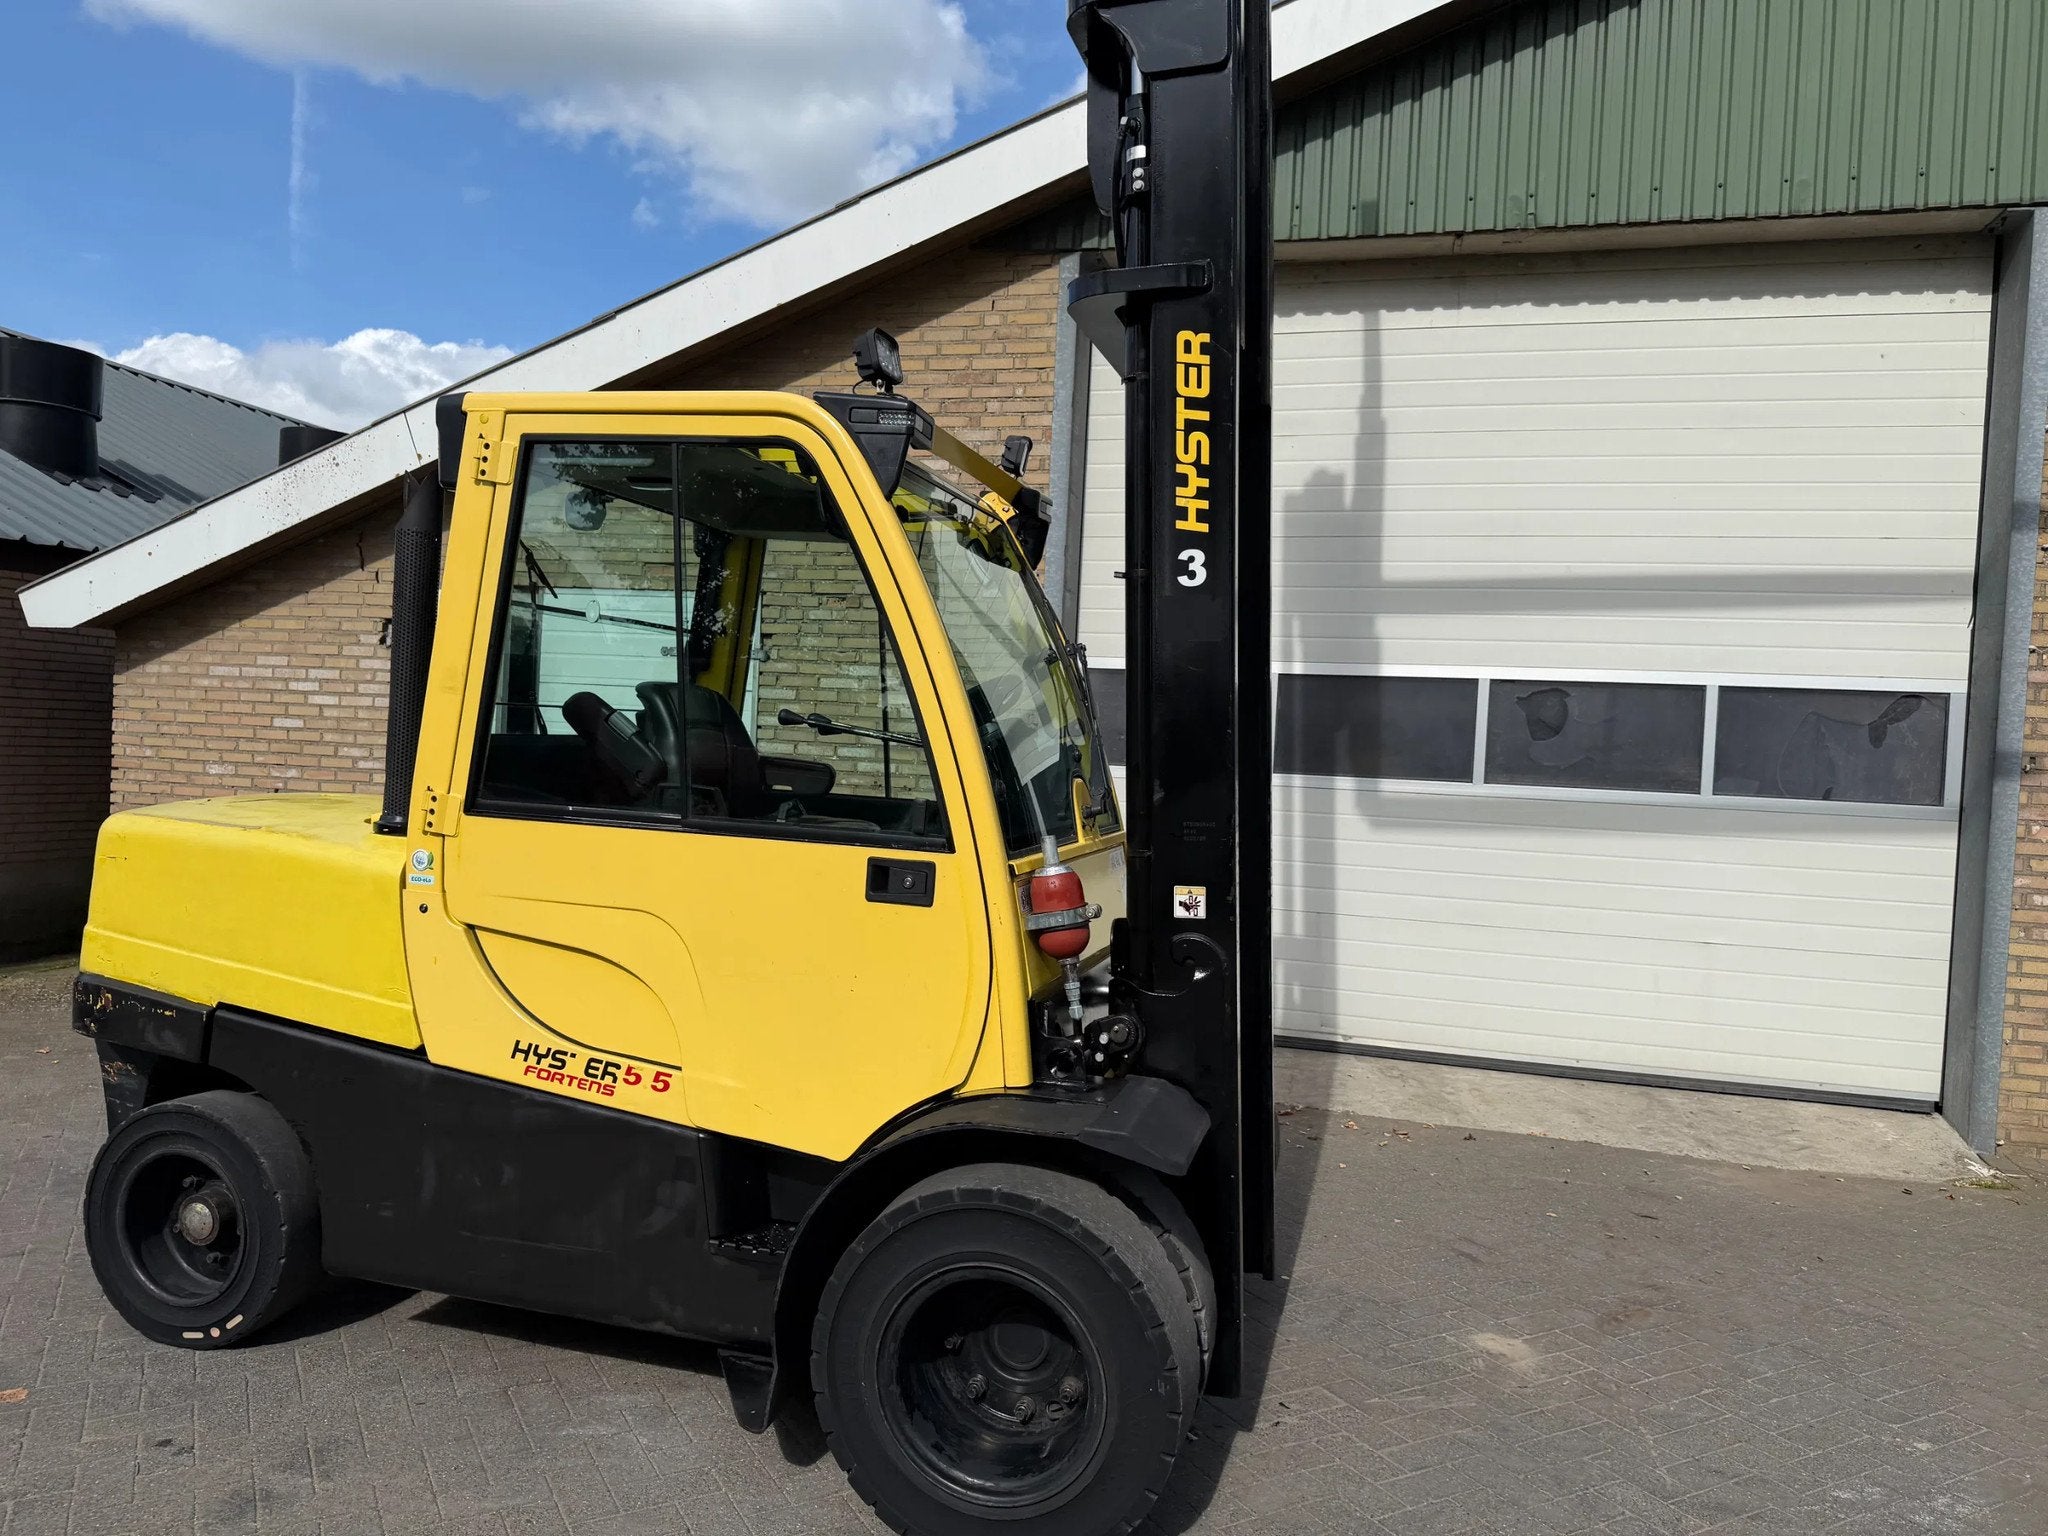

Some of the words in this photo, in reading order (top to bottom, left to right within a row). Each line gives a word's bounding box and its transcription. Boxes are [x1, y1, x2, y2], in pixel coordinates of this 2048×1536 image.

[1175, 330, 1211, 533] HYSTER
[1176, 549, 1207, 588] 3
[523, 1065, 616, 1097] FORTENS
